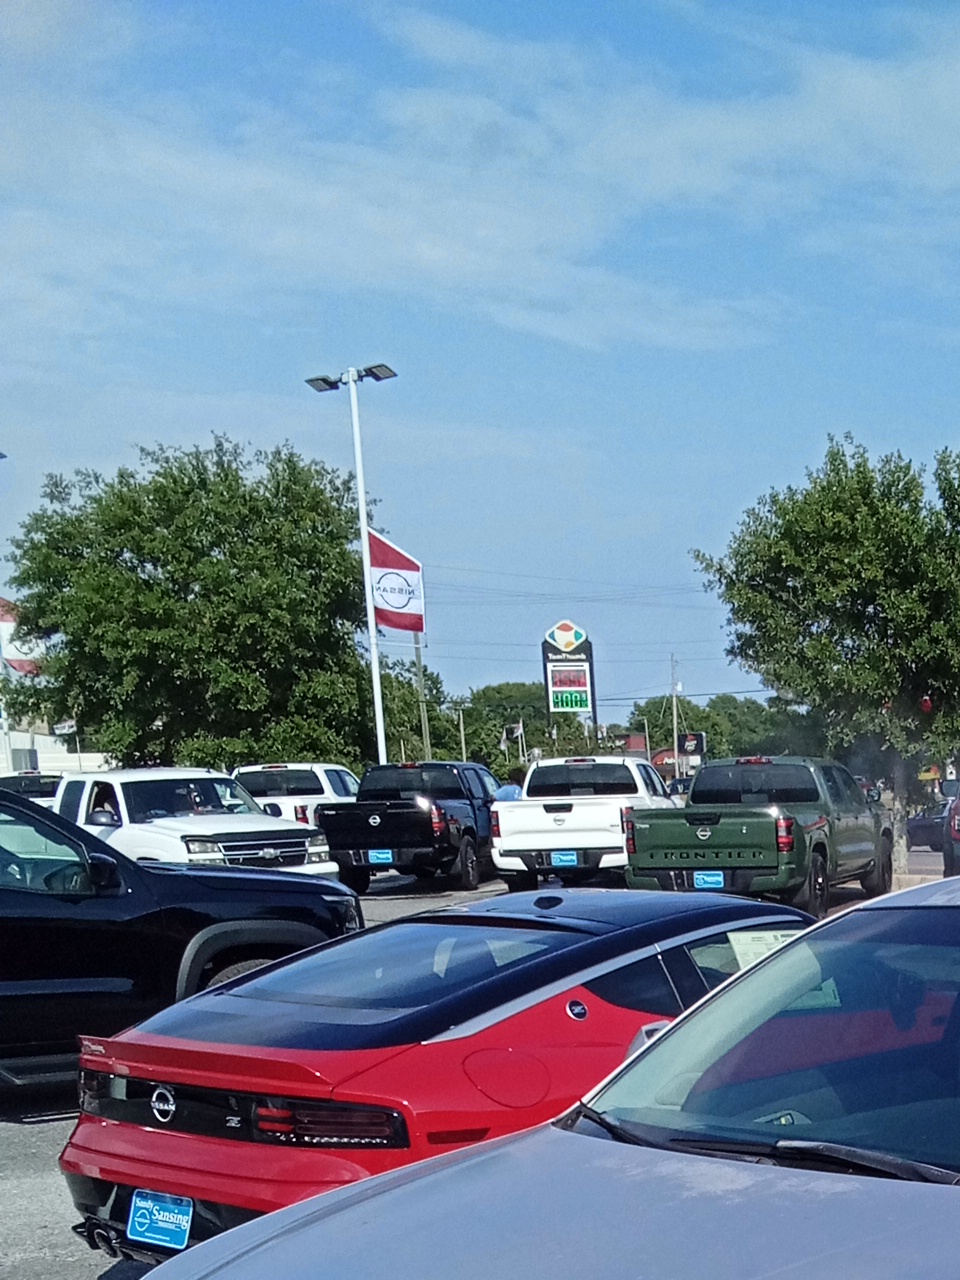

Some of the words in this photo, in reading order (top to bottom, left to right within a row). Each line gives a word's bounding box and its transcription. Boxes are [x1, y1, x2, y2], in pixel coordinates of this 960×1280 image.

[649, 851, 764, 860] FRONTIER
[150, 1100, 177, 1111] NISSAN
[136, 1198, 154, 1211] Sandy
[152, 1206, 189, 1230] Sansing
